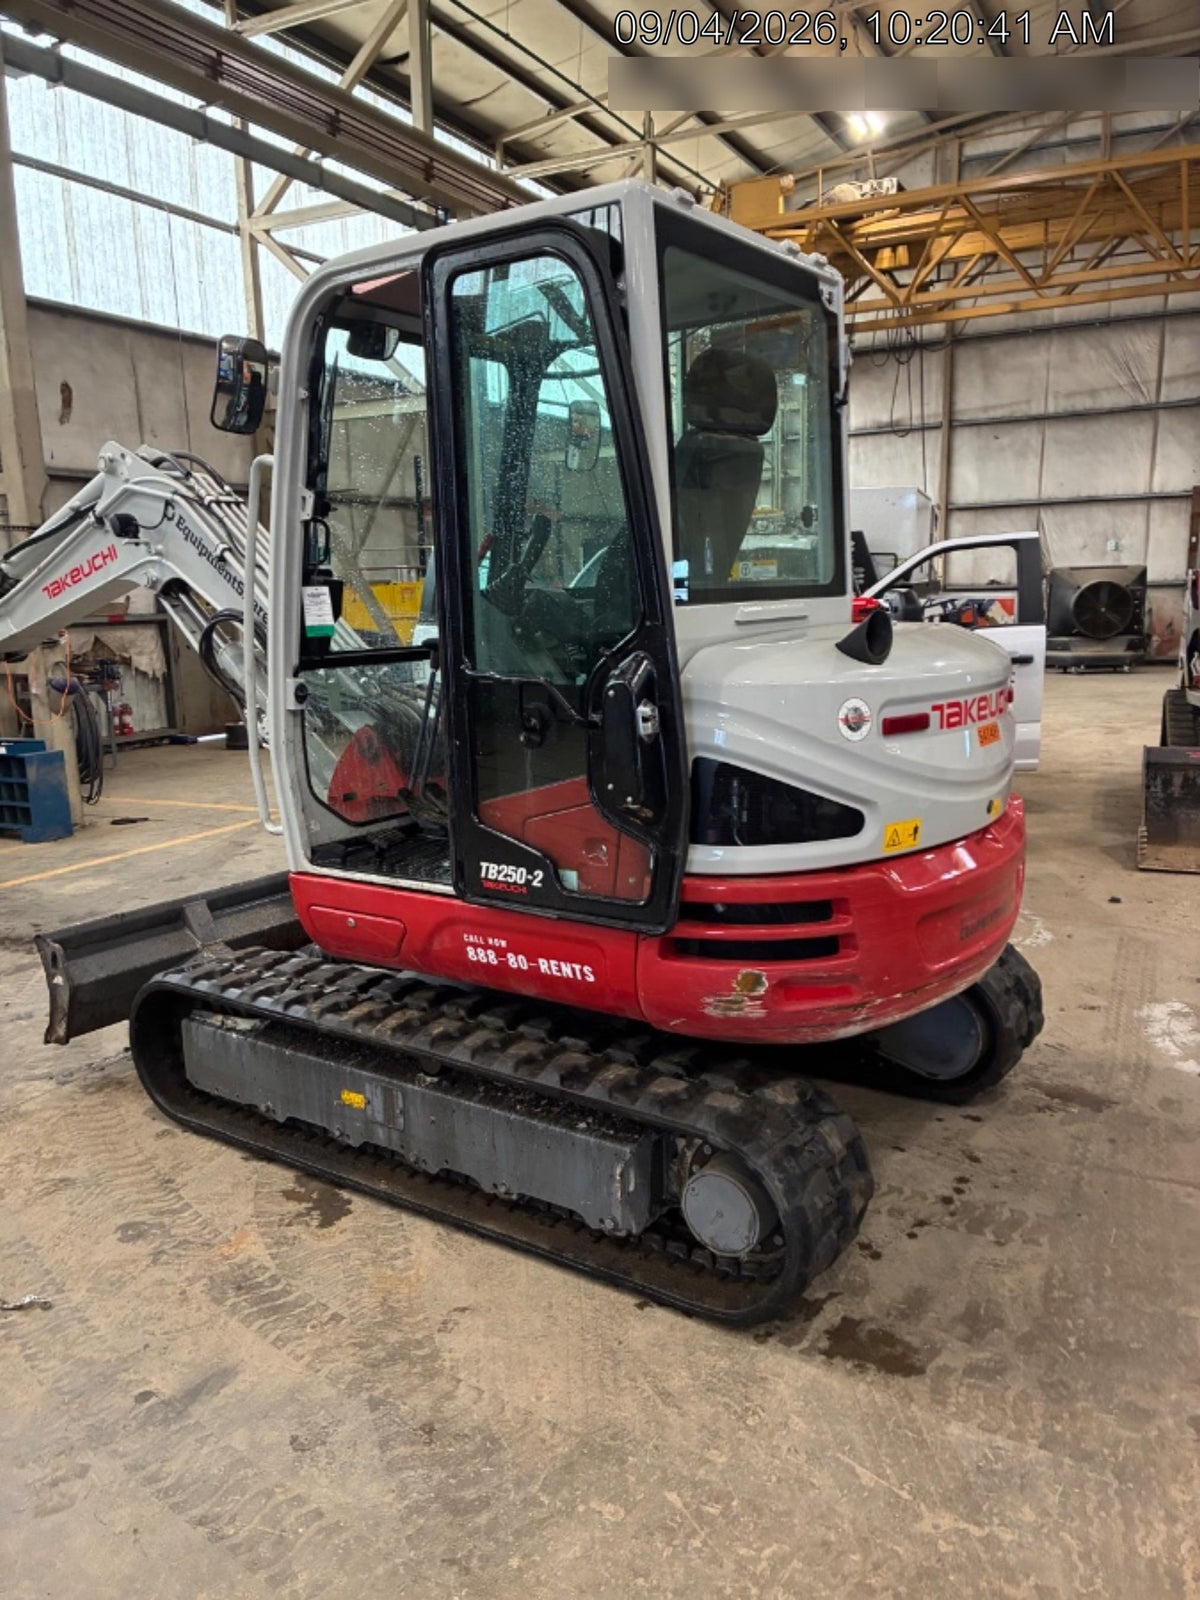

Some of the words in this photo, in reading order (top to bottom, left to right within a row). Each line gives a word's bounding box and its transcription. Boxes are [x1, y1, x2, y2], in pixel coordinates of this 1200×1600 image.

[42, 543, 118, 600] TAKEUCHI
[479, 861, 543, 887] TB250-2
[463, 933, 484, 944] CALL
[487, 937, 507, 948] NOW
[466, 946, 595, 982] 888-80-RENTS
